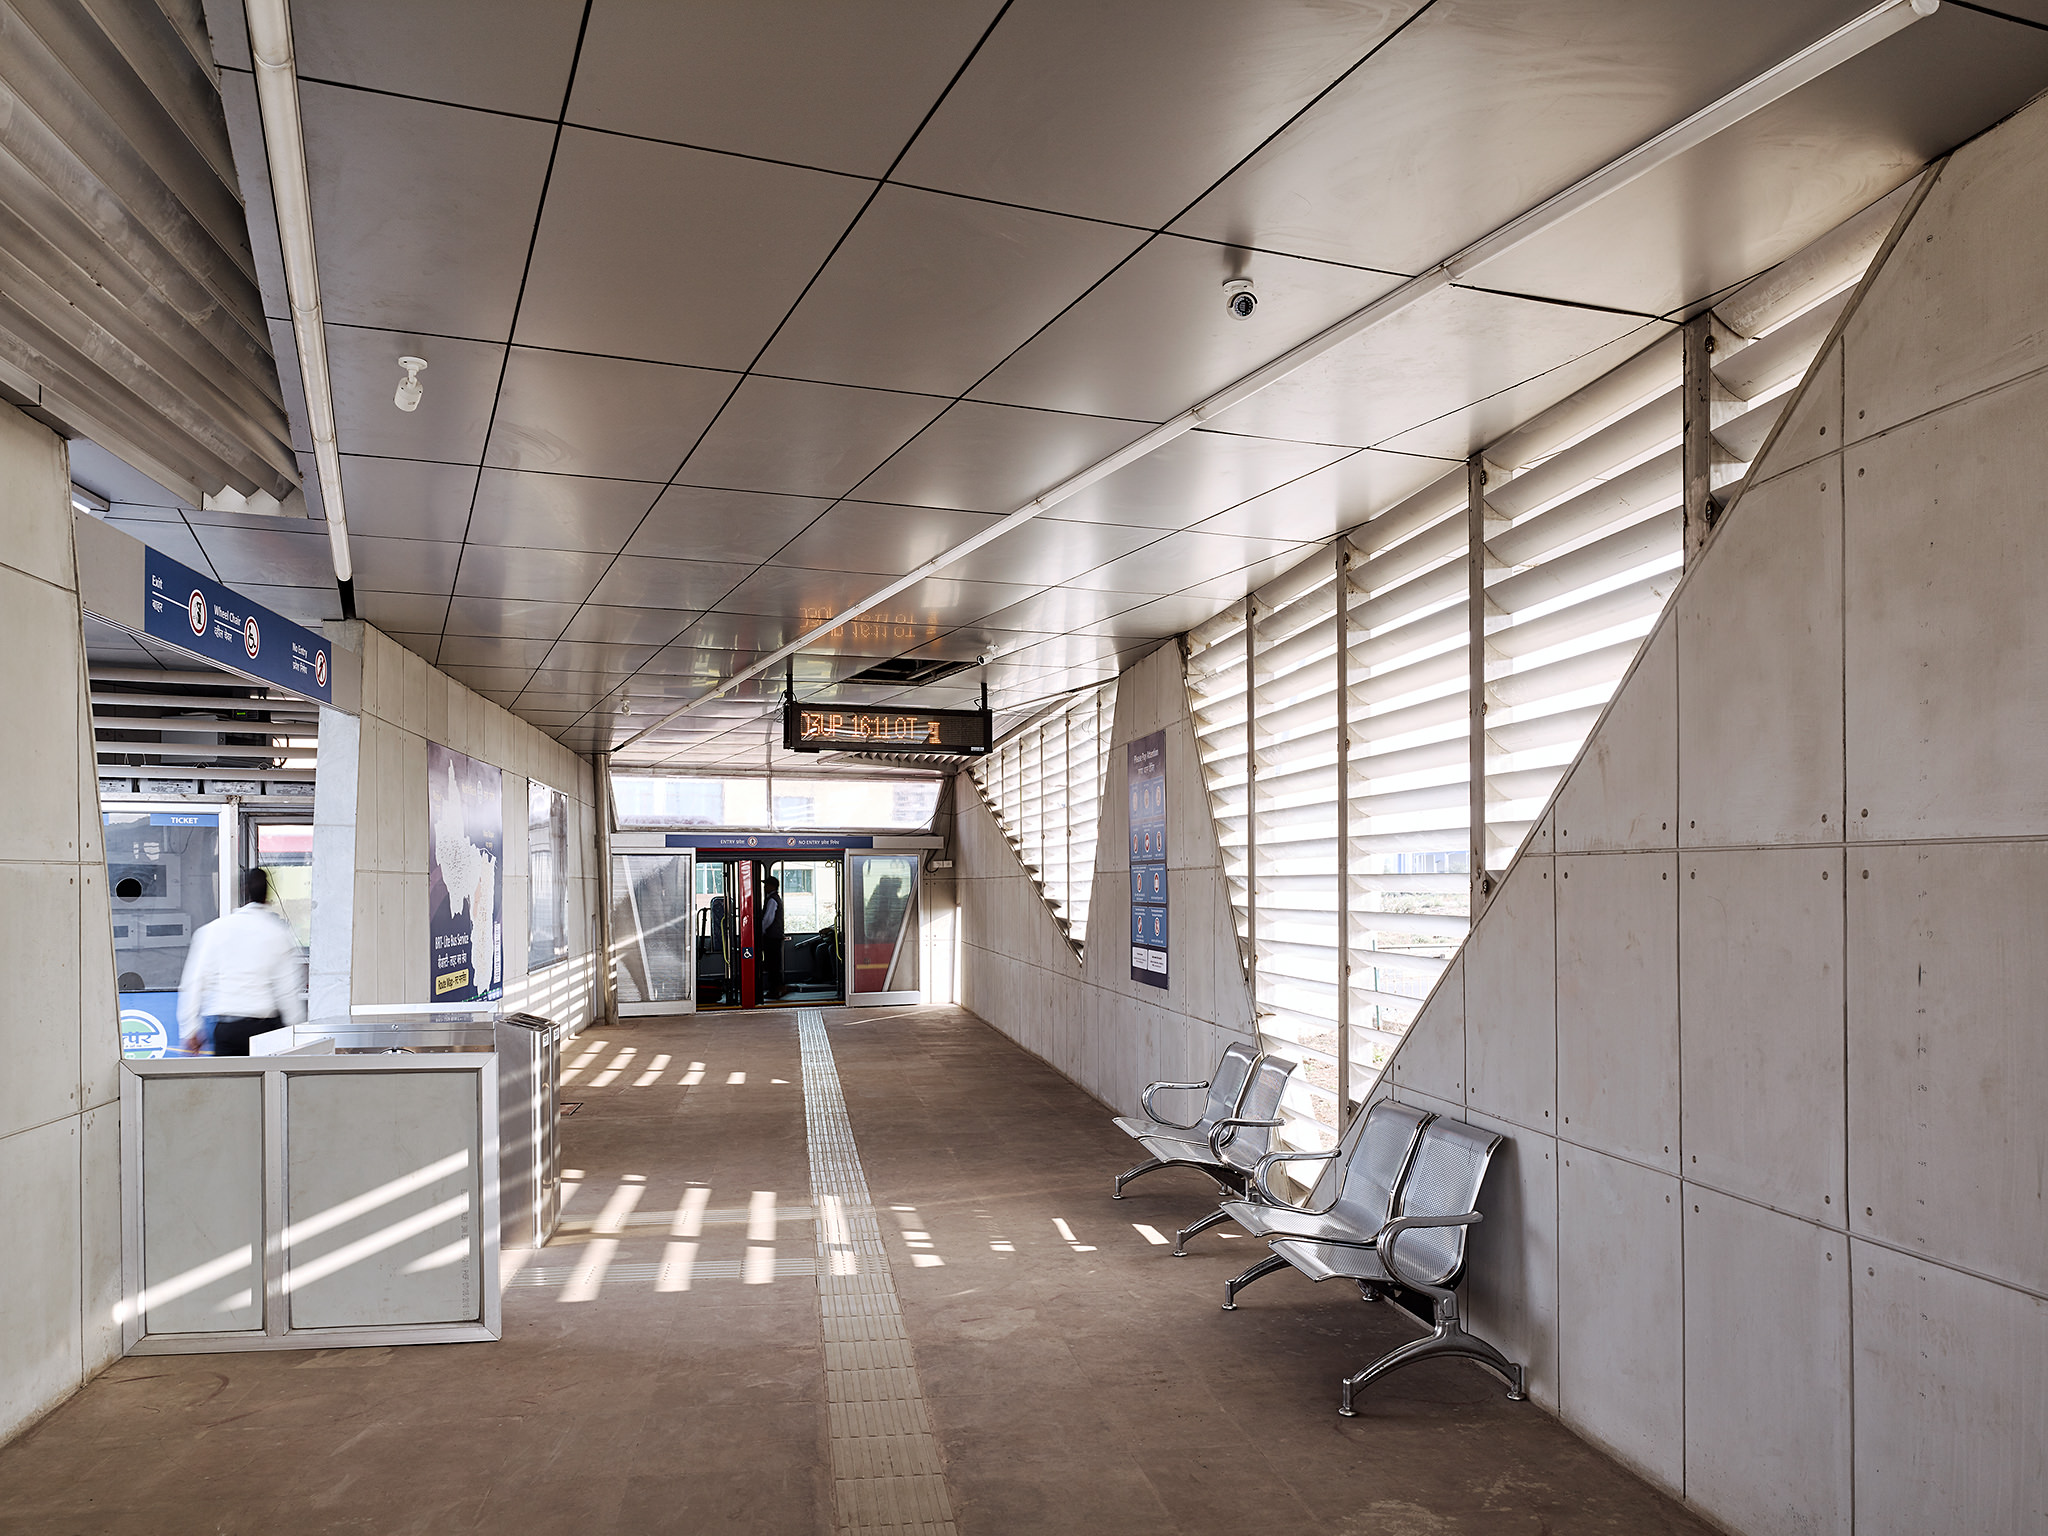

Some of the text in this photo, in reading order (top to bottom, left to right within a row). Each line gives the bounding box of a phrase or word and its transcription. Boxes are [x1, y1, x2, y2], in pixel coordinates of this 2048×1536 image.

[152, 574, 163, 590] Exit
[213, 604, 241, 627] Wheel Chair
[292, 642, 308, 659] No Entry
[852, 715, 891, 738] 16:11
[170, 816, 199, 825] TICKET
[457, 932, 469, 946] Service
[438, 980, 446, 990] Route
